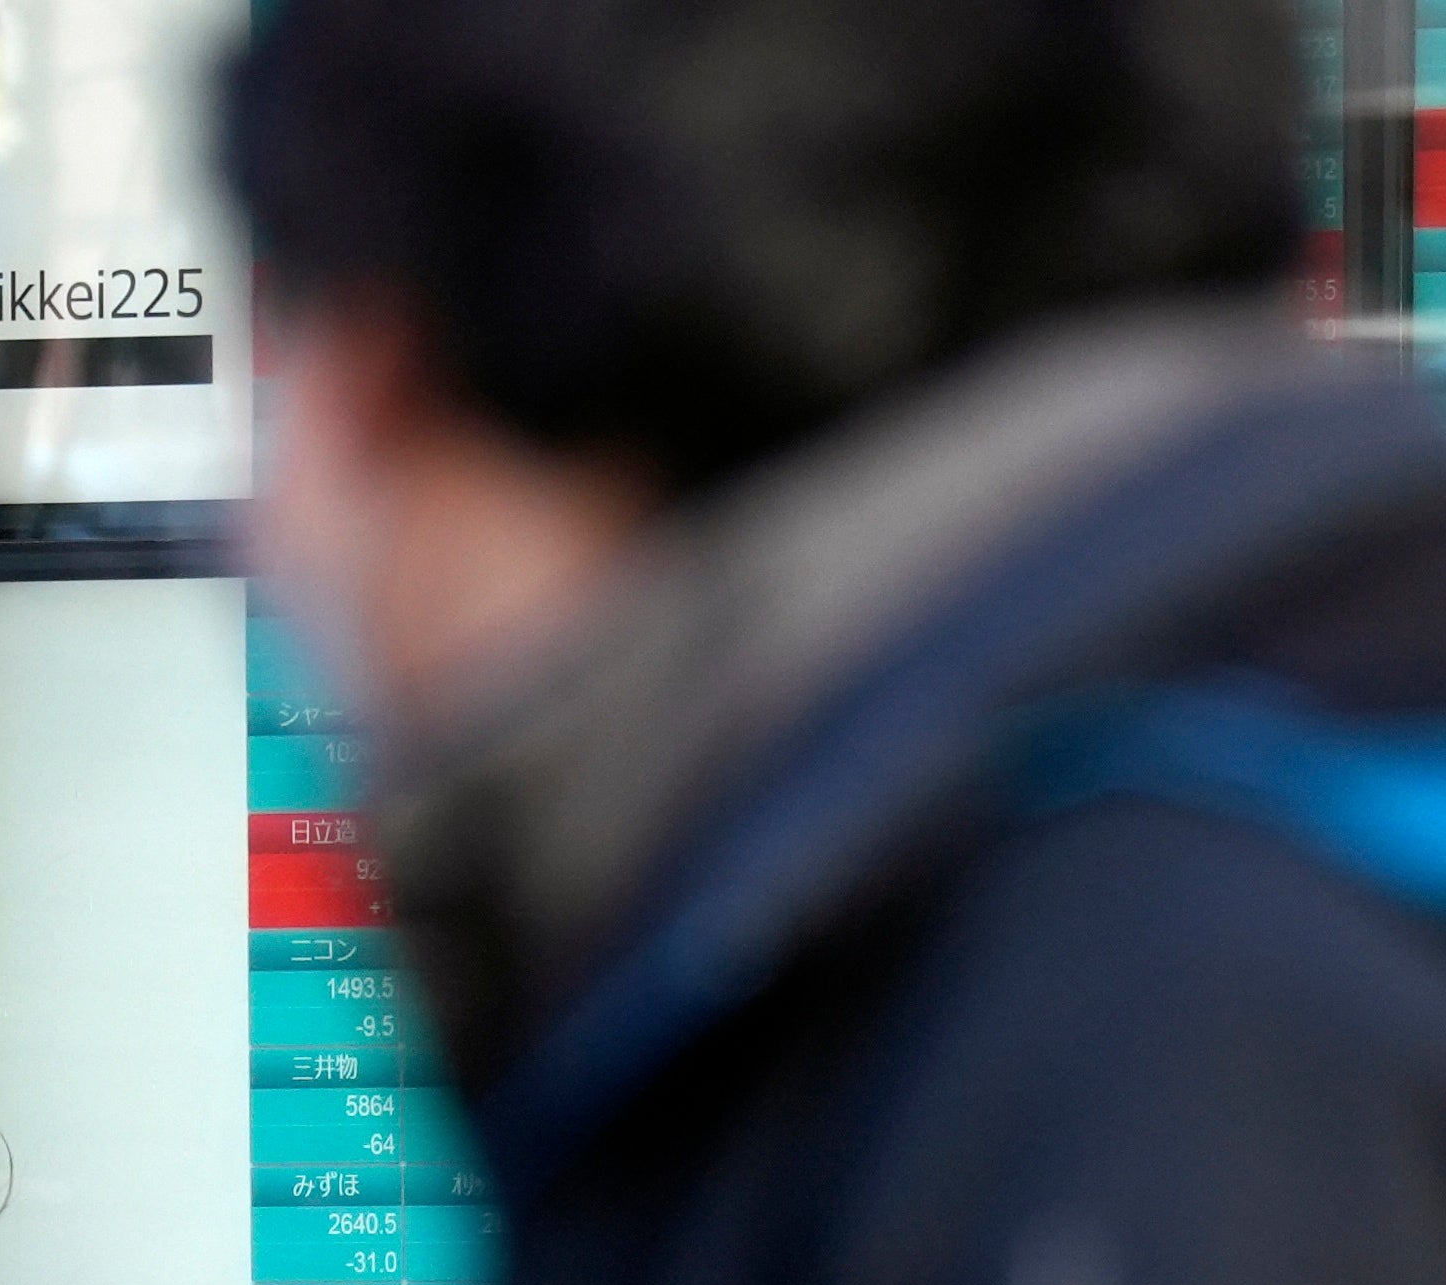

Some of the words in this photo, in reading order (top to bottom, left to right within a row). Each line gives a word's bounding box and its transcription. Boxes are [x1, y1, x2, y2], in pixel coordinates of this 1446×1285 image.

[279, 702, 344, 727] シャー
[291, 939, 357, 961] ニコン
[326, 976, 394, 999] 1493.5
[356, 1015, 394, 1037] -9.5
[291, 1056, 358, 1080] 三井物
[345, 1095, 394, 1117] 5864
[363, 1133, 395, 1155] -64
[292, 1173, 360, 1197] みずほ
[328, 1213, 397, 1235] 2640.5
[345, 1252, 397, 1274] -31.0
